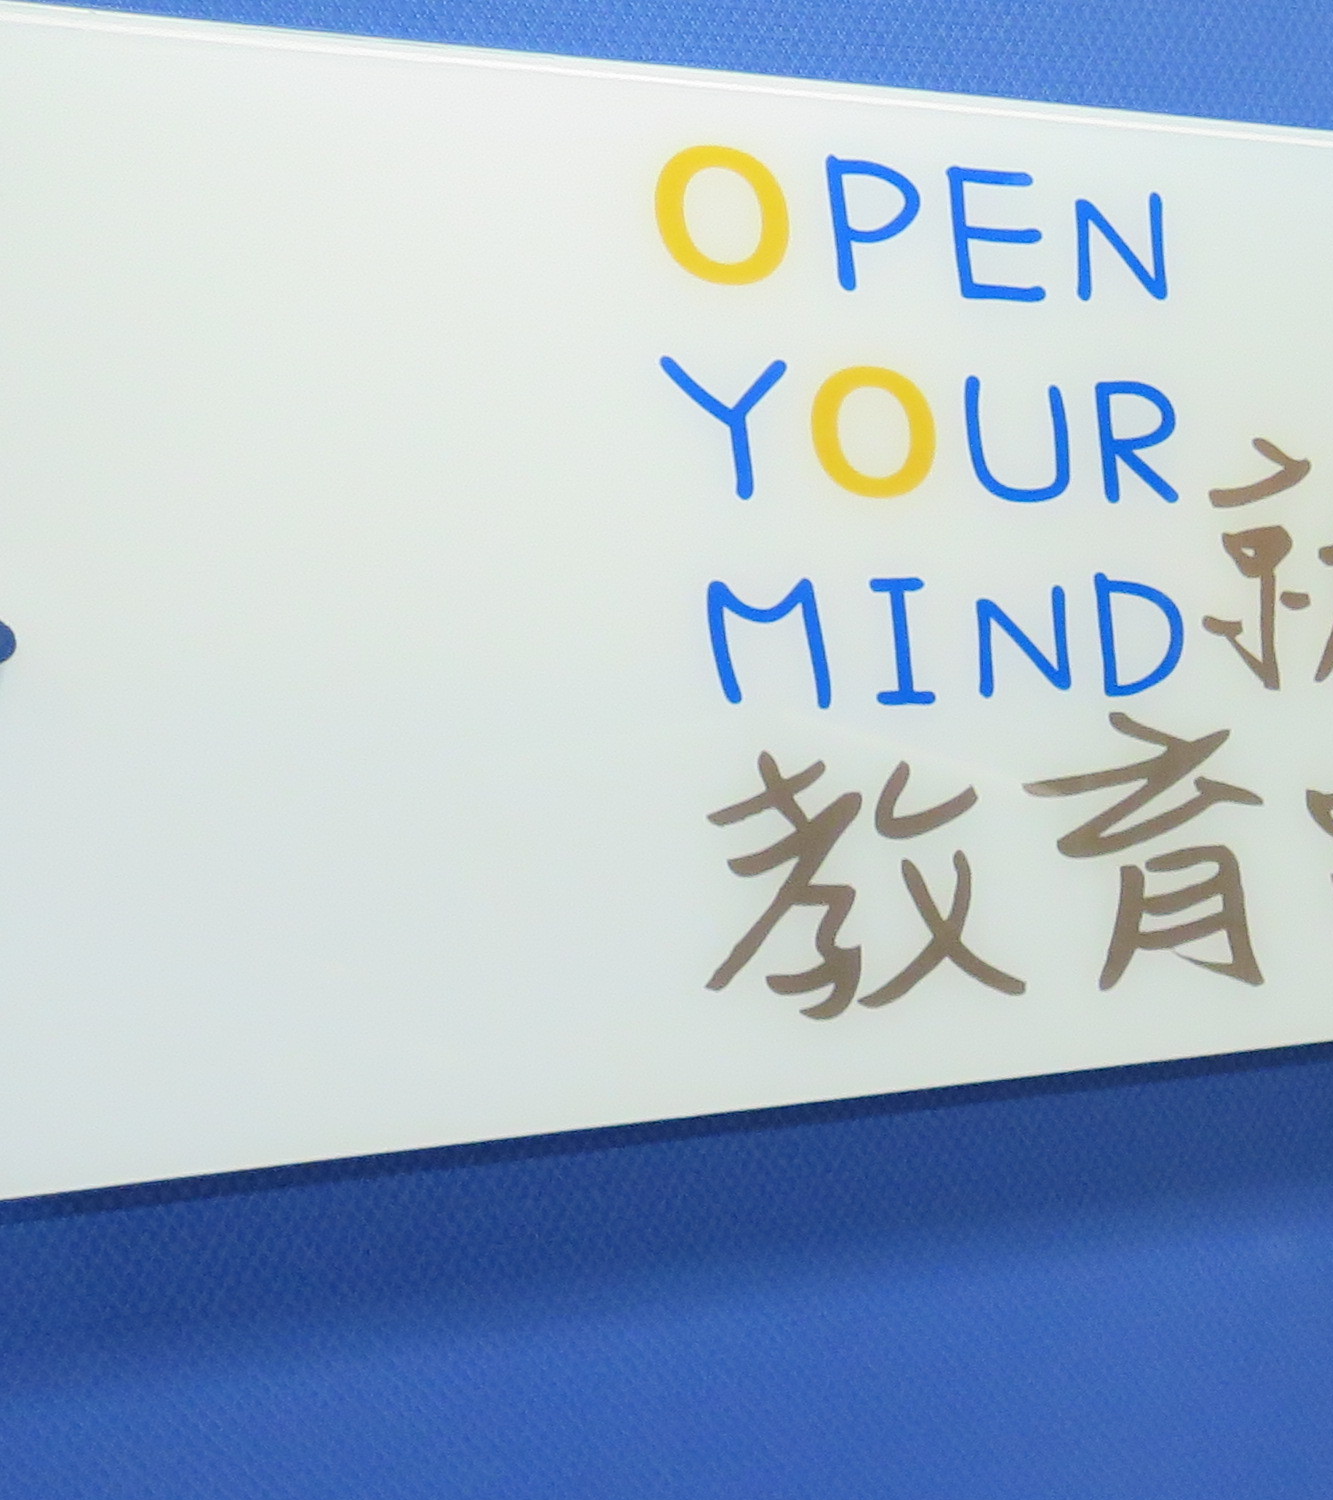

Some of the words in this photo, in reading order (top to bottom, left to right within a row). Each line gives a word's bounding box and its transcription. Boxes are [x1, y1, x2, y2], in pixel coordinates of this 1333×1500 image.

[654, 145, 1169, 303] OPEN
[659, 355, 1180, 504] YOUR
[706, 570, 1185, 710] MIND
